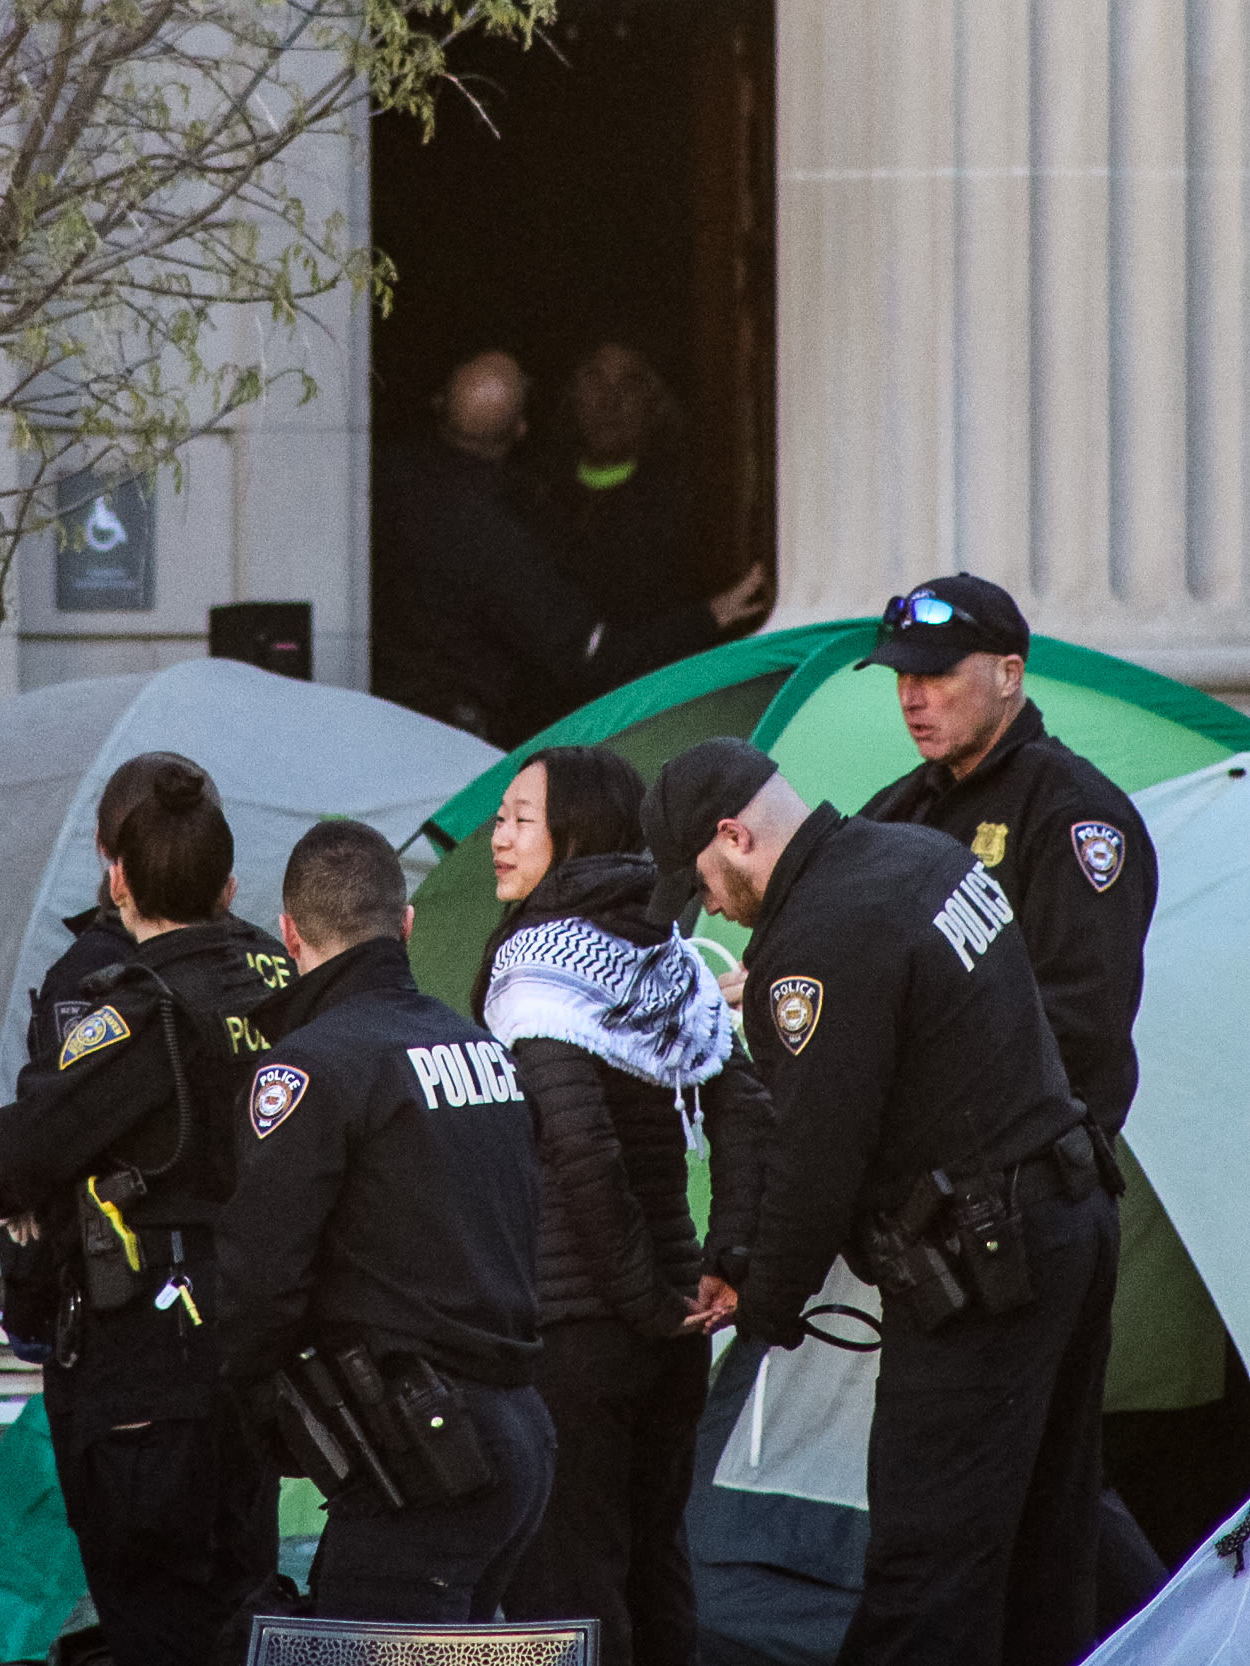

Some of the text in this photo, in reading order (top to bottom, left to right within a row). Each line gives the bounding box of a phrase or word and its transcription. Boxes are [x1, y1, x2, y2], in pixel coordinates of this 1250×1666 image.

[1077, 826, 1120, 848] POLICE
[773, 981, 816, 1002] POLICE
[259, 1069, 301, 1091] POLICE
[406, 1041, 525, 1110] POLICE
